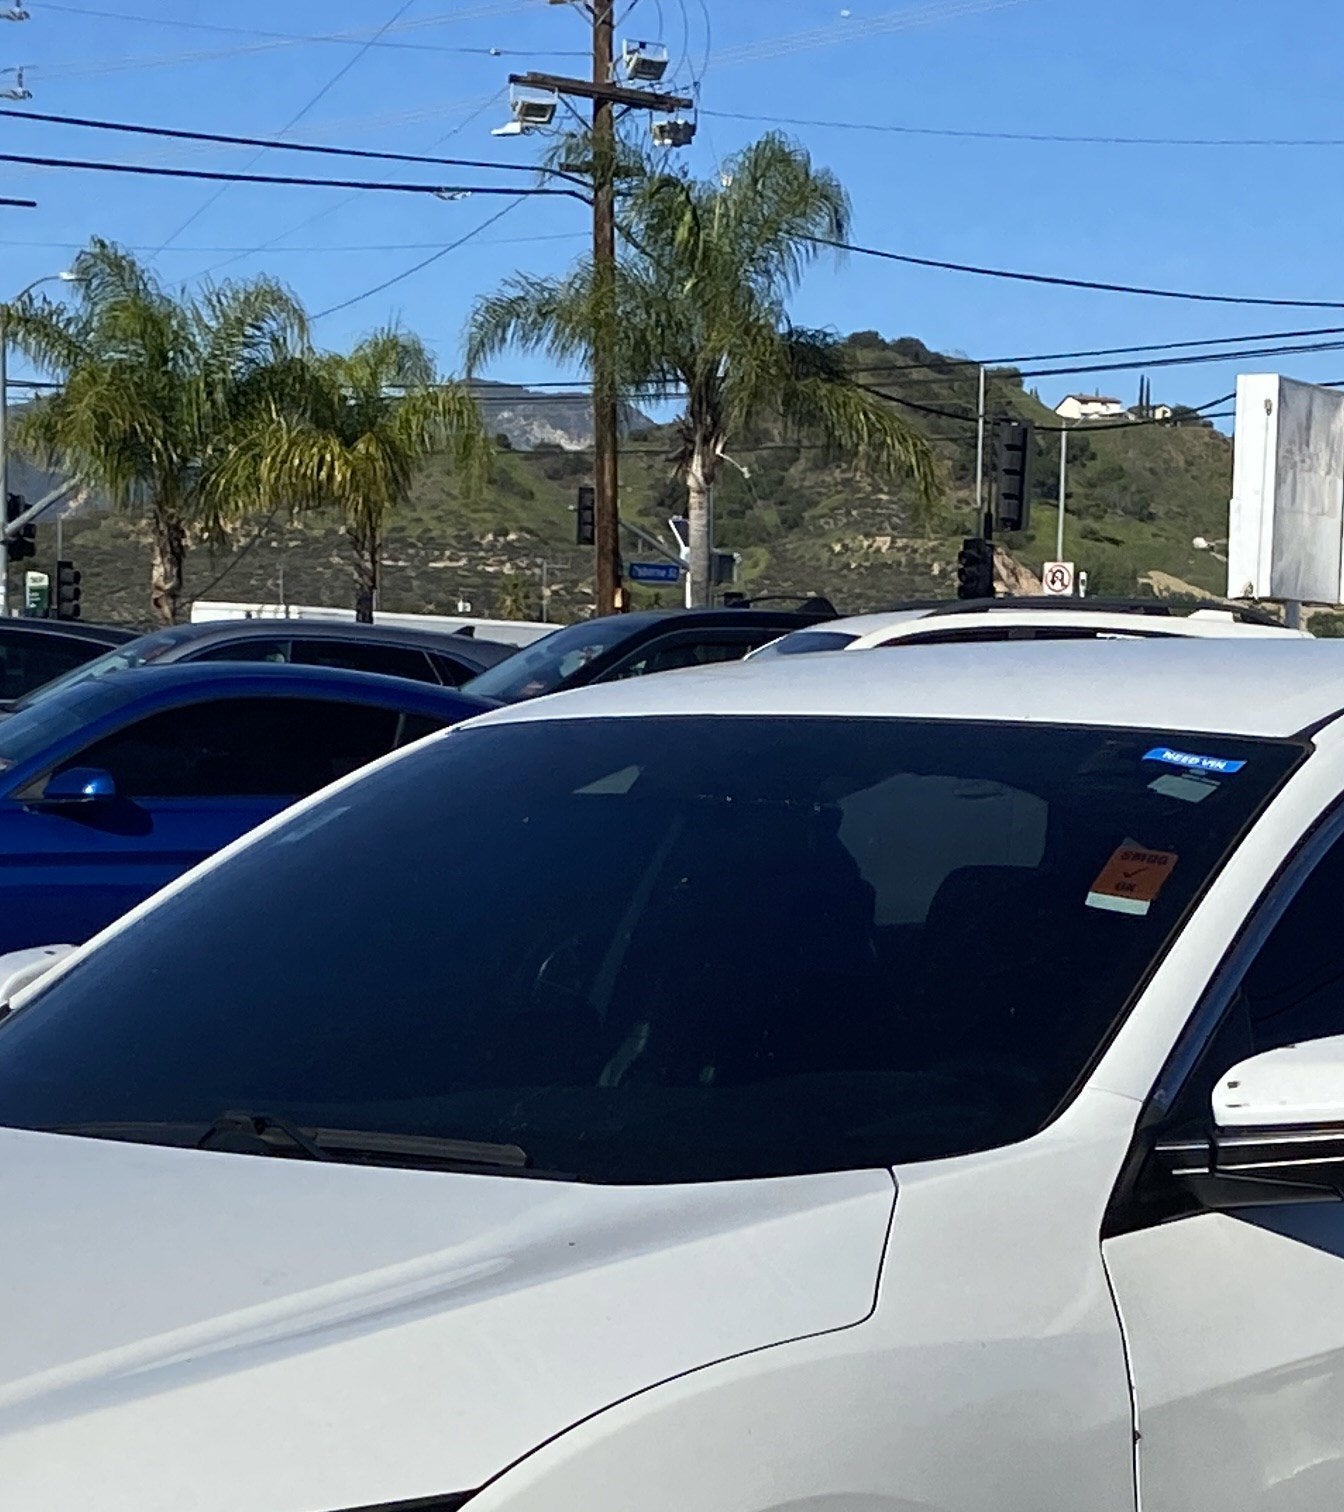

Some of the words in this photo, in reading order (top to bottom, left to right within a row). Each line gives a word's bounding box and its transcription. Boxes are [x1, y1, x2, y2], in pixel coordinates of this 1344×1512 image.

[1162, 751, 1201, 765] NEED
[1202, 758, 1227, 770] VIN
[1120, 851, 1168, 866] SMOG
[1115, 880, 1136, 892] OK
